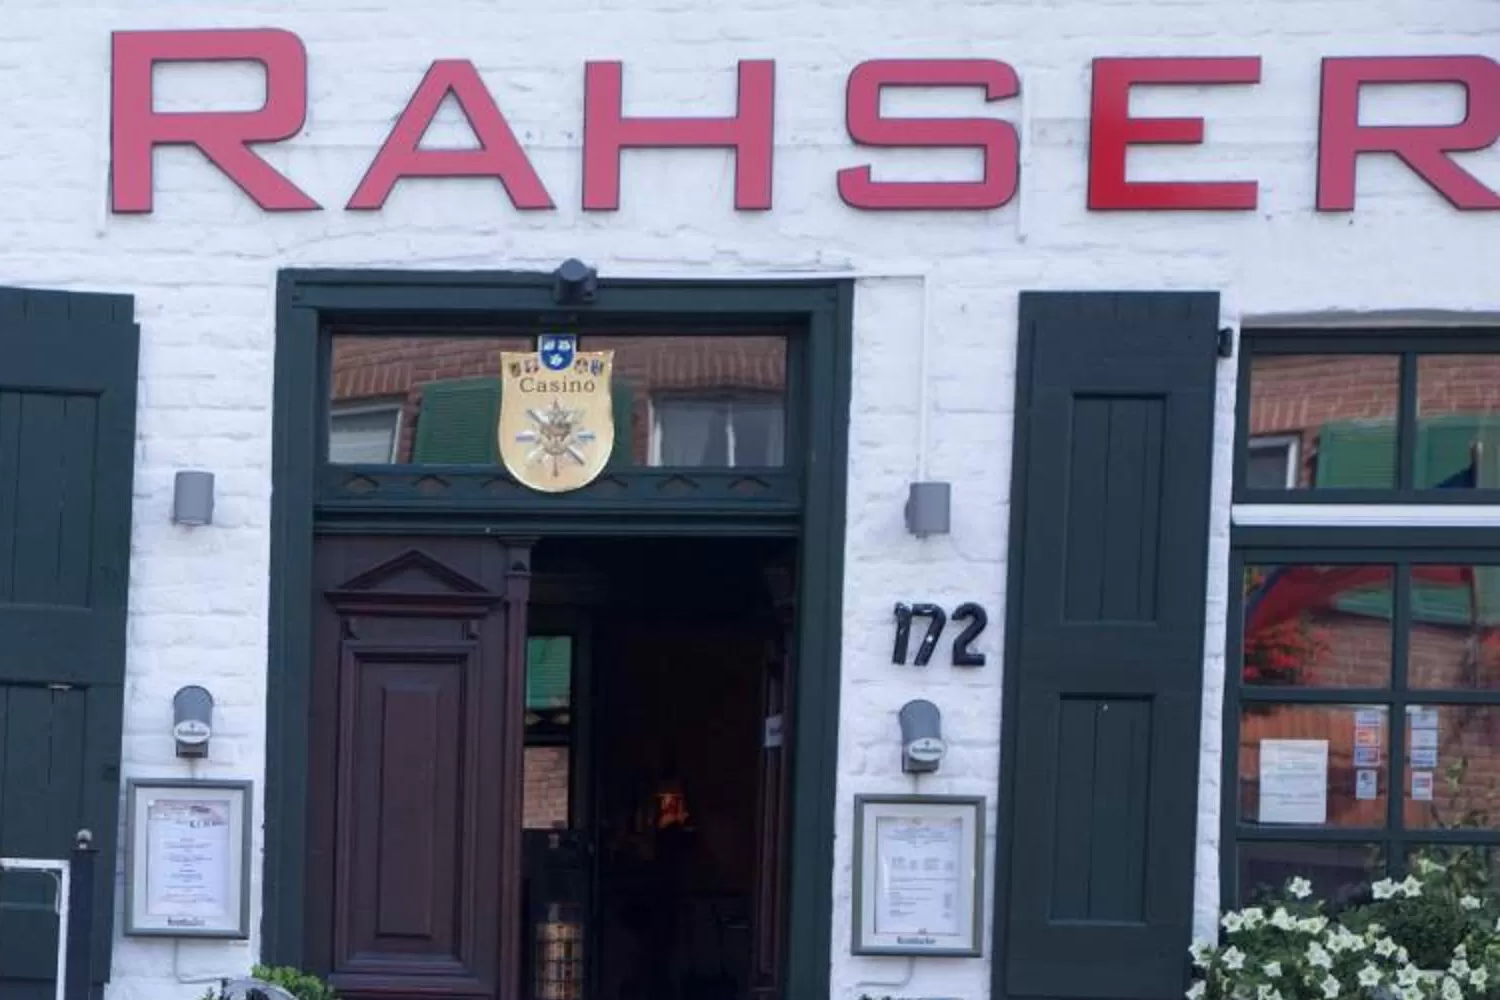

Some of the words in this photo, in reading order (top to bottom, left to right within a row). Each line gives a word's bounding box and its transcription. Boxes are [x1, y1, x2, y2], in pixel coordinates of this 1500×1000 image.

[109, 27, 1500, 214] RAHSER
[519, 375, 596, 394] Casino
[891, 601, 989, 667] 172
